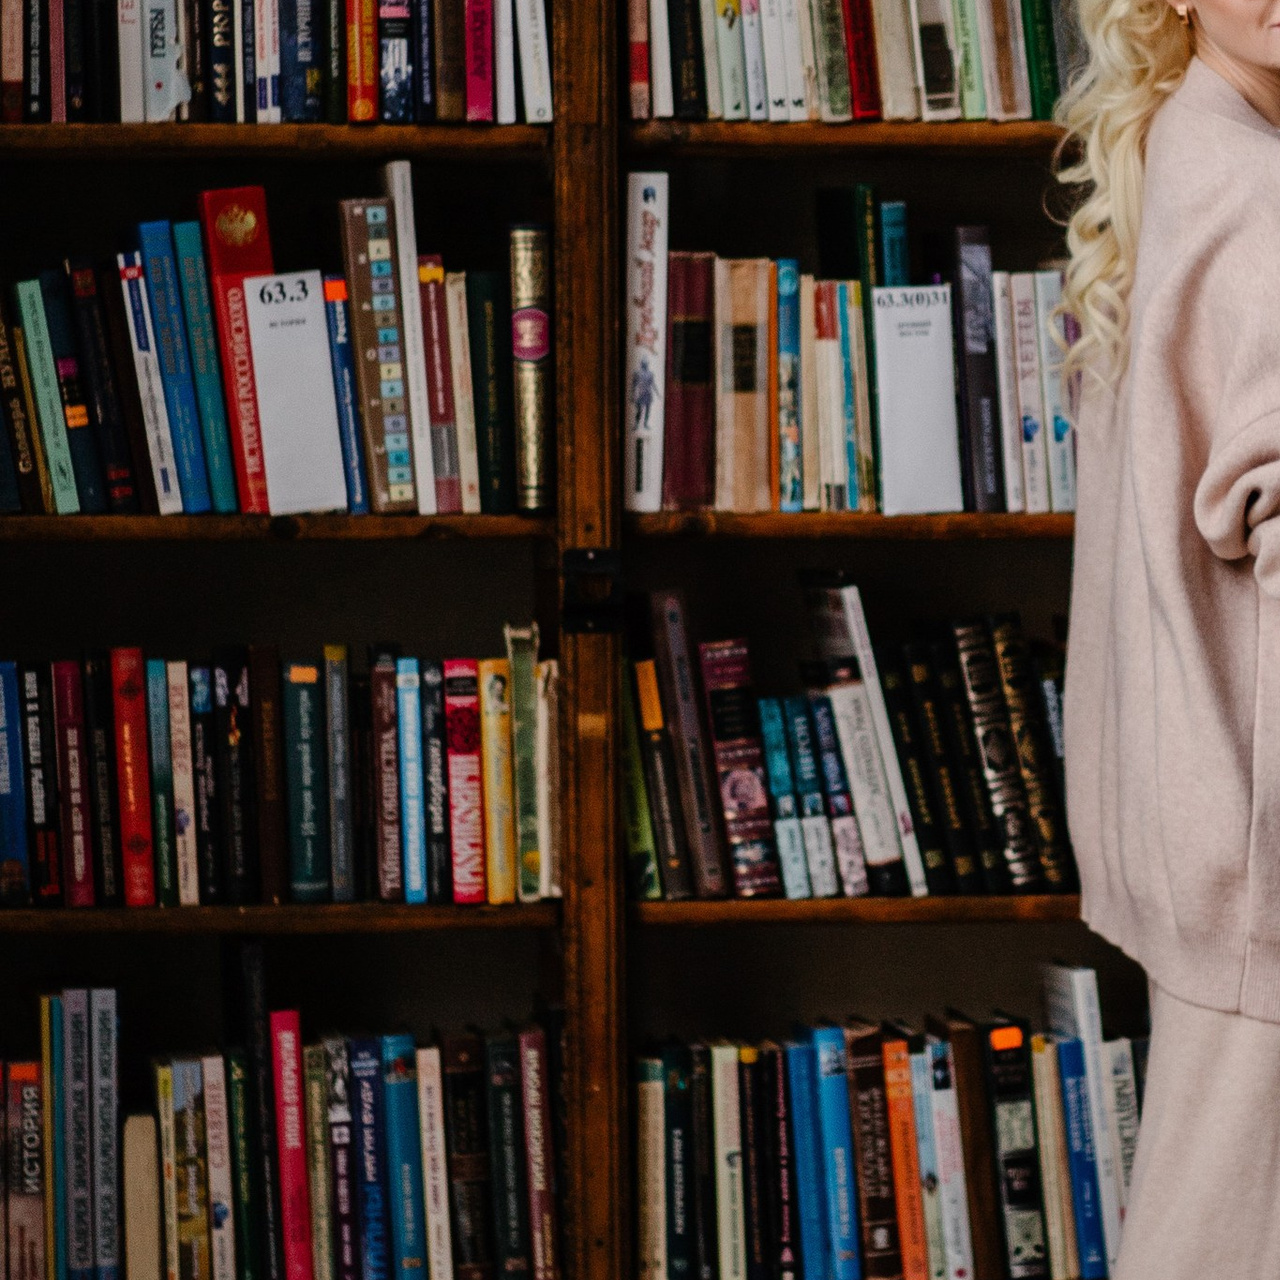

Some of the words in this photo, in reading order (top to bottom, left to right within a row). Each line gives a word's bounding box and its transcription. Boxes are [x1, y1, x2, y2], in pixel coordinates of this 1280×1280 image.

[147, 9, 166, 59] ГЕРБЫ
[258, 279, 310, 304] 63.3
[334, 301, 348, 344] Росси
[876, 287, 950, 308] 63.3(0)31
[228, 287, 255, 399] РОССИЙСКОГО
[1014, 298, 1036, 382] ХЕТТЫ
[241, 401, 262, 474] ИСТОРИЯ
[69, 1011, 84, 1083] ЖЕНЩИН
[97, 1008, 112, 1081] ЖЕНЩИН
[21, 1086, 42, 1195] ИСТОРИЯ
[71, 1088, 87, 1192] ЗНАМЕНИТЫХ
[98, 1086, 115, 1189] ЗНАМЕНИТЫХ
[72, 1197, 89, 1262] ГАЛЕРЕЯ
[101, 1194, 116, 1259] ГАЛЕРЕЯ
